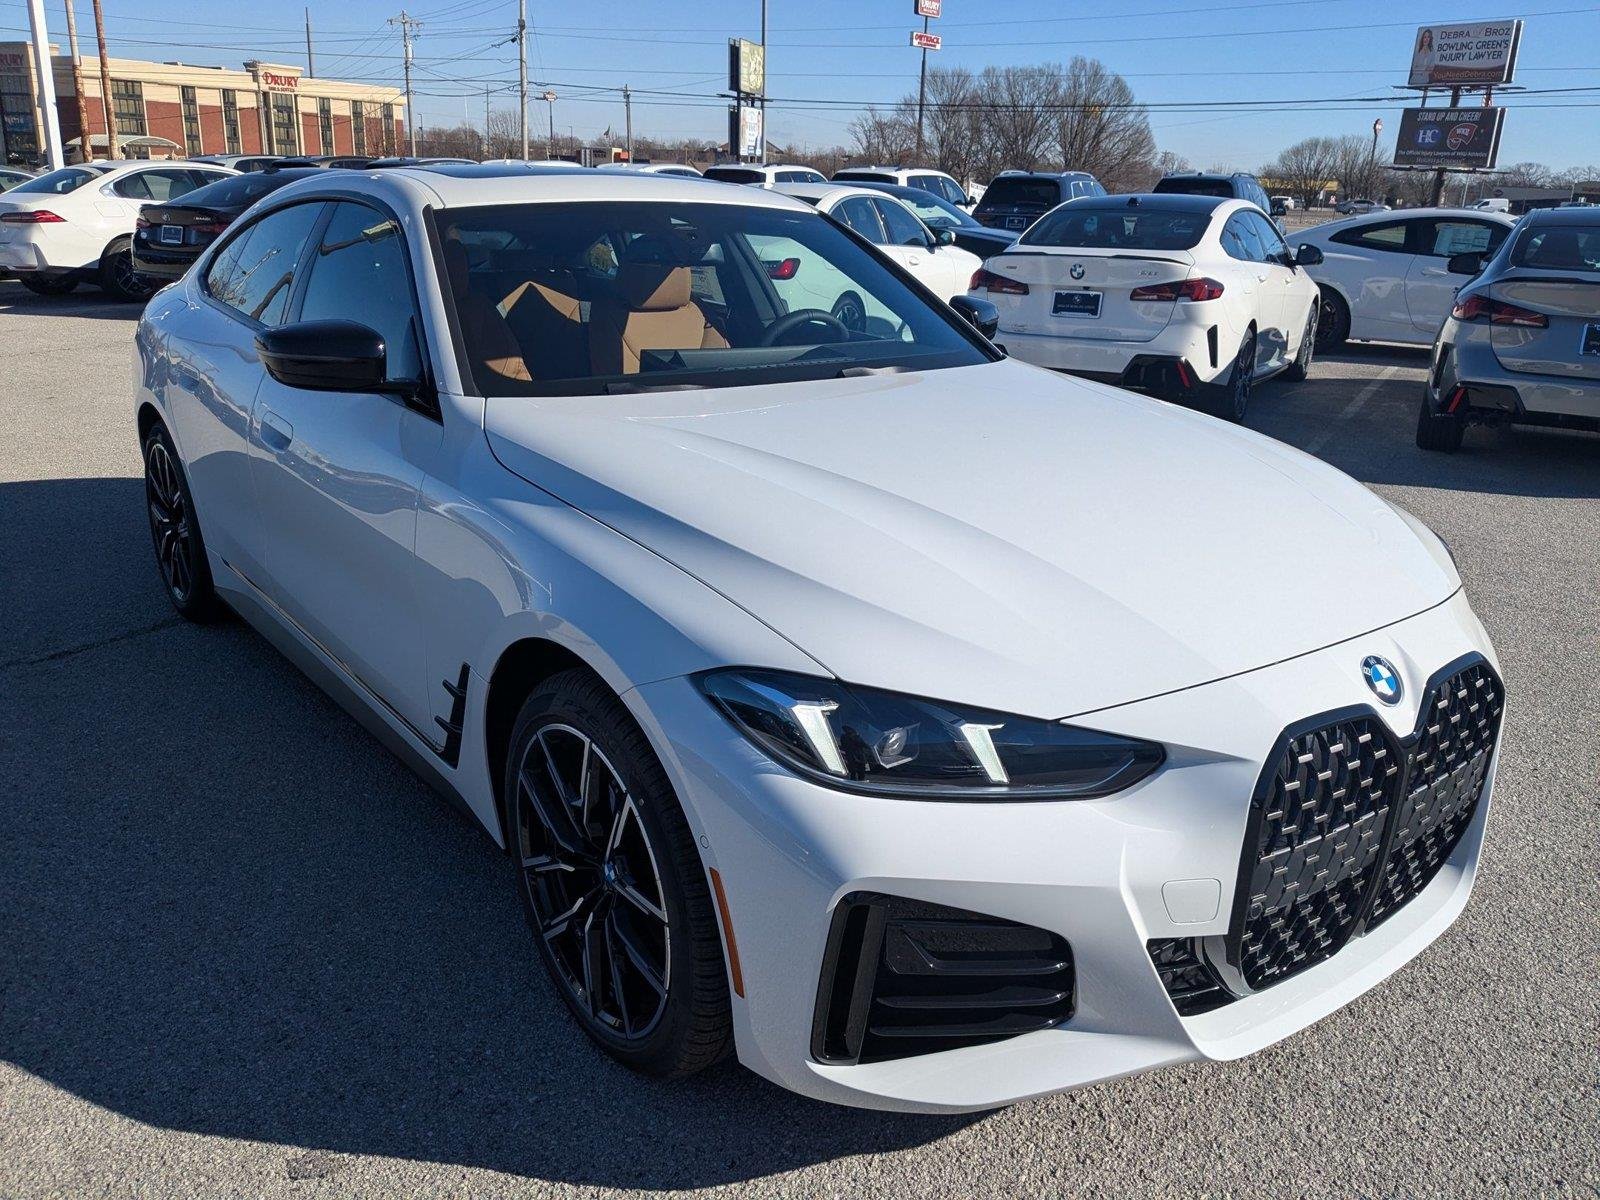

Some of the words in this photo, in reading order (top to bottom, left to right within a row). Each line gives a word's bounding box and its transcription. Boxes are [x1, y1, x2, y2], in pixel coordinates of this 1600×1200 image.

[1440, 31, 1470, 40] DEBRA
[1484, 28, 1511, 37] BROZ
[1437, 41, 1474, 52] BOWLING
[1475, 39, 1510, 50] GREEN'S
[1439, 52, 1468, 62] INJURY
[1468, 50, 1503, 61] LAWYER
[262, 71, 299, 87] DRURY
[1433, 70, 1504, 80] YouNeedDebra.com
[1416, 111, 1437, 122] STAND
[1436, 112, 1446, 122] UP
[1445, 112, 1459, 122] AND
[1458, 112, 1482, 122] CHEER!
